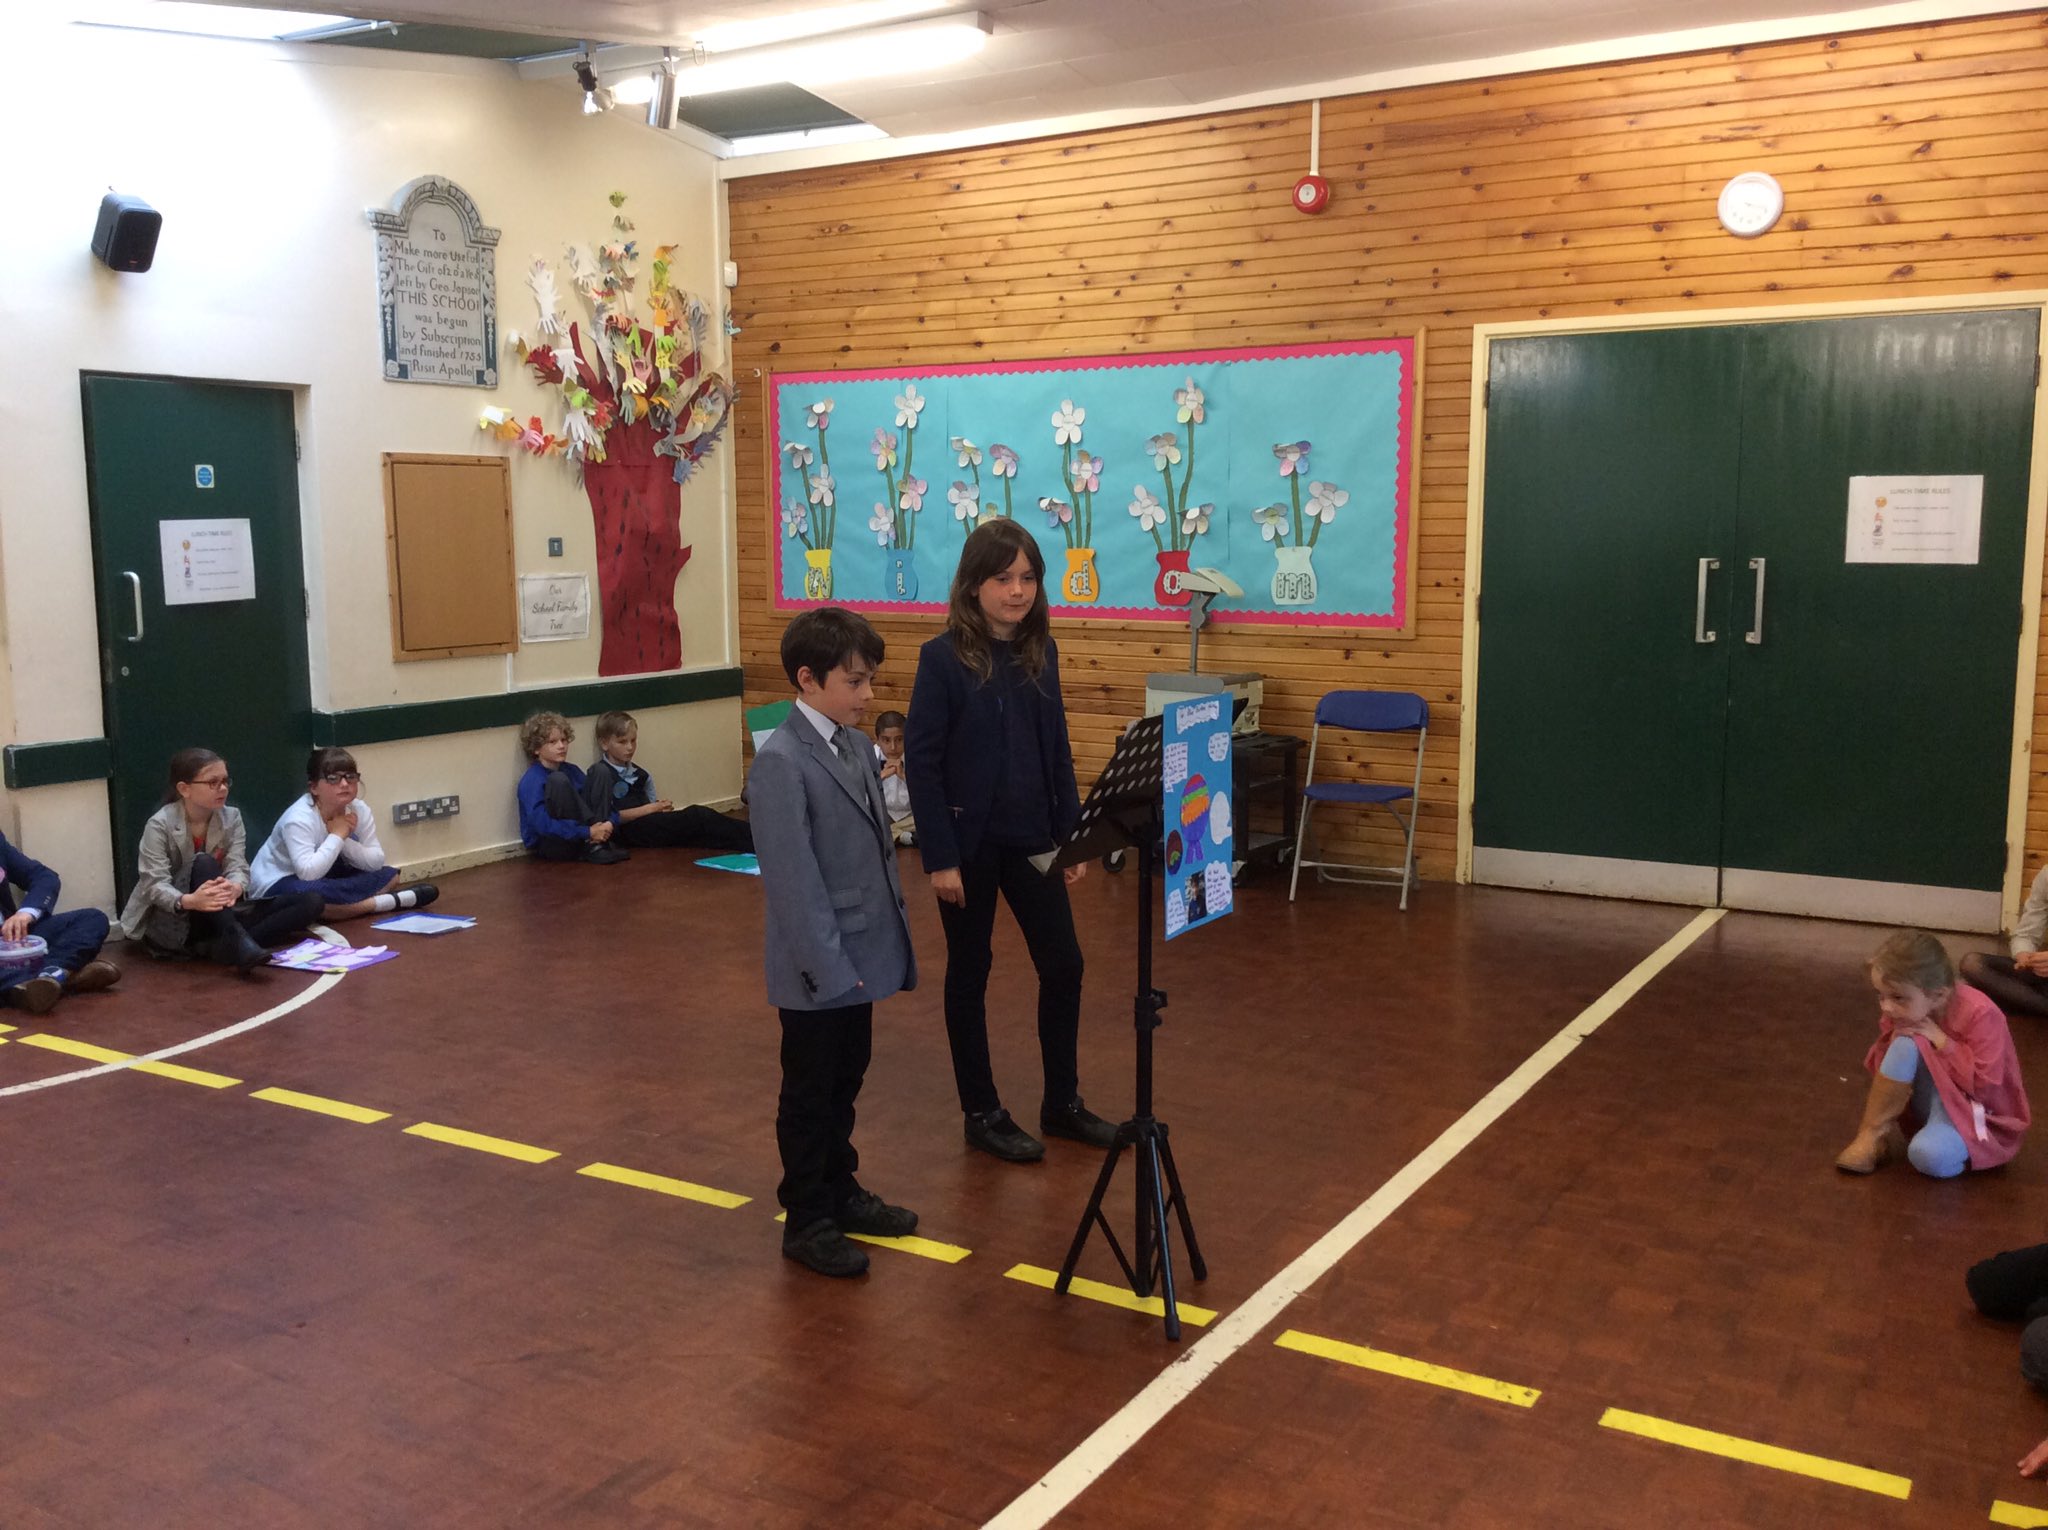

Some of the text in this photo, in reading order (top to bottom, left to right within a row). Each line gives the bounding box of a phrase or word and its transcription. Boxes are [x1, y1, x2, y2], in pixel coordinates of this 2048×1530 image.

[433, 229, 446, 241] To
[395, 239, 480, 263] Make more Useful
[395, 256, 415, 271] The
[416, 275, 427, 290] by
[429, 277, 449, 292] Geo
[397, 289, 428, 306] THIS
[415, 311, 468, 330] was begun
[402, 325, 481, 349] by Subscription
[400, 344, 417, 356] and
[420, 343, 456, 359] finished
[440, 362, 473, 379] Apollo
[532, 601, 578, 614] School Family
[550, 619, 563, 630] Tree
